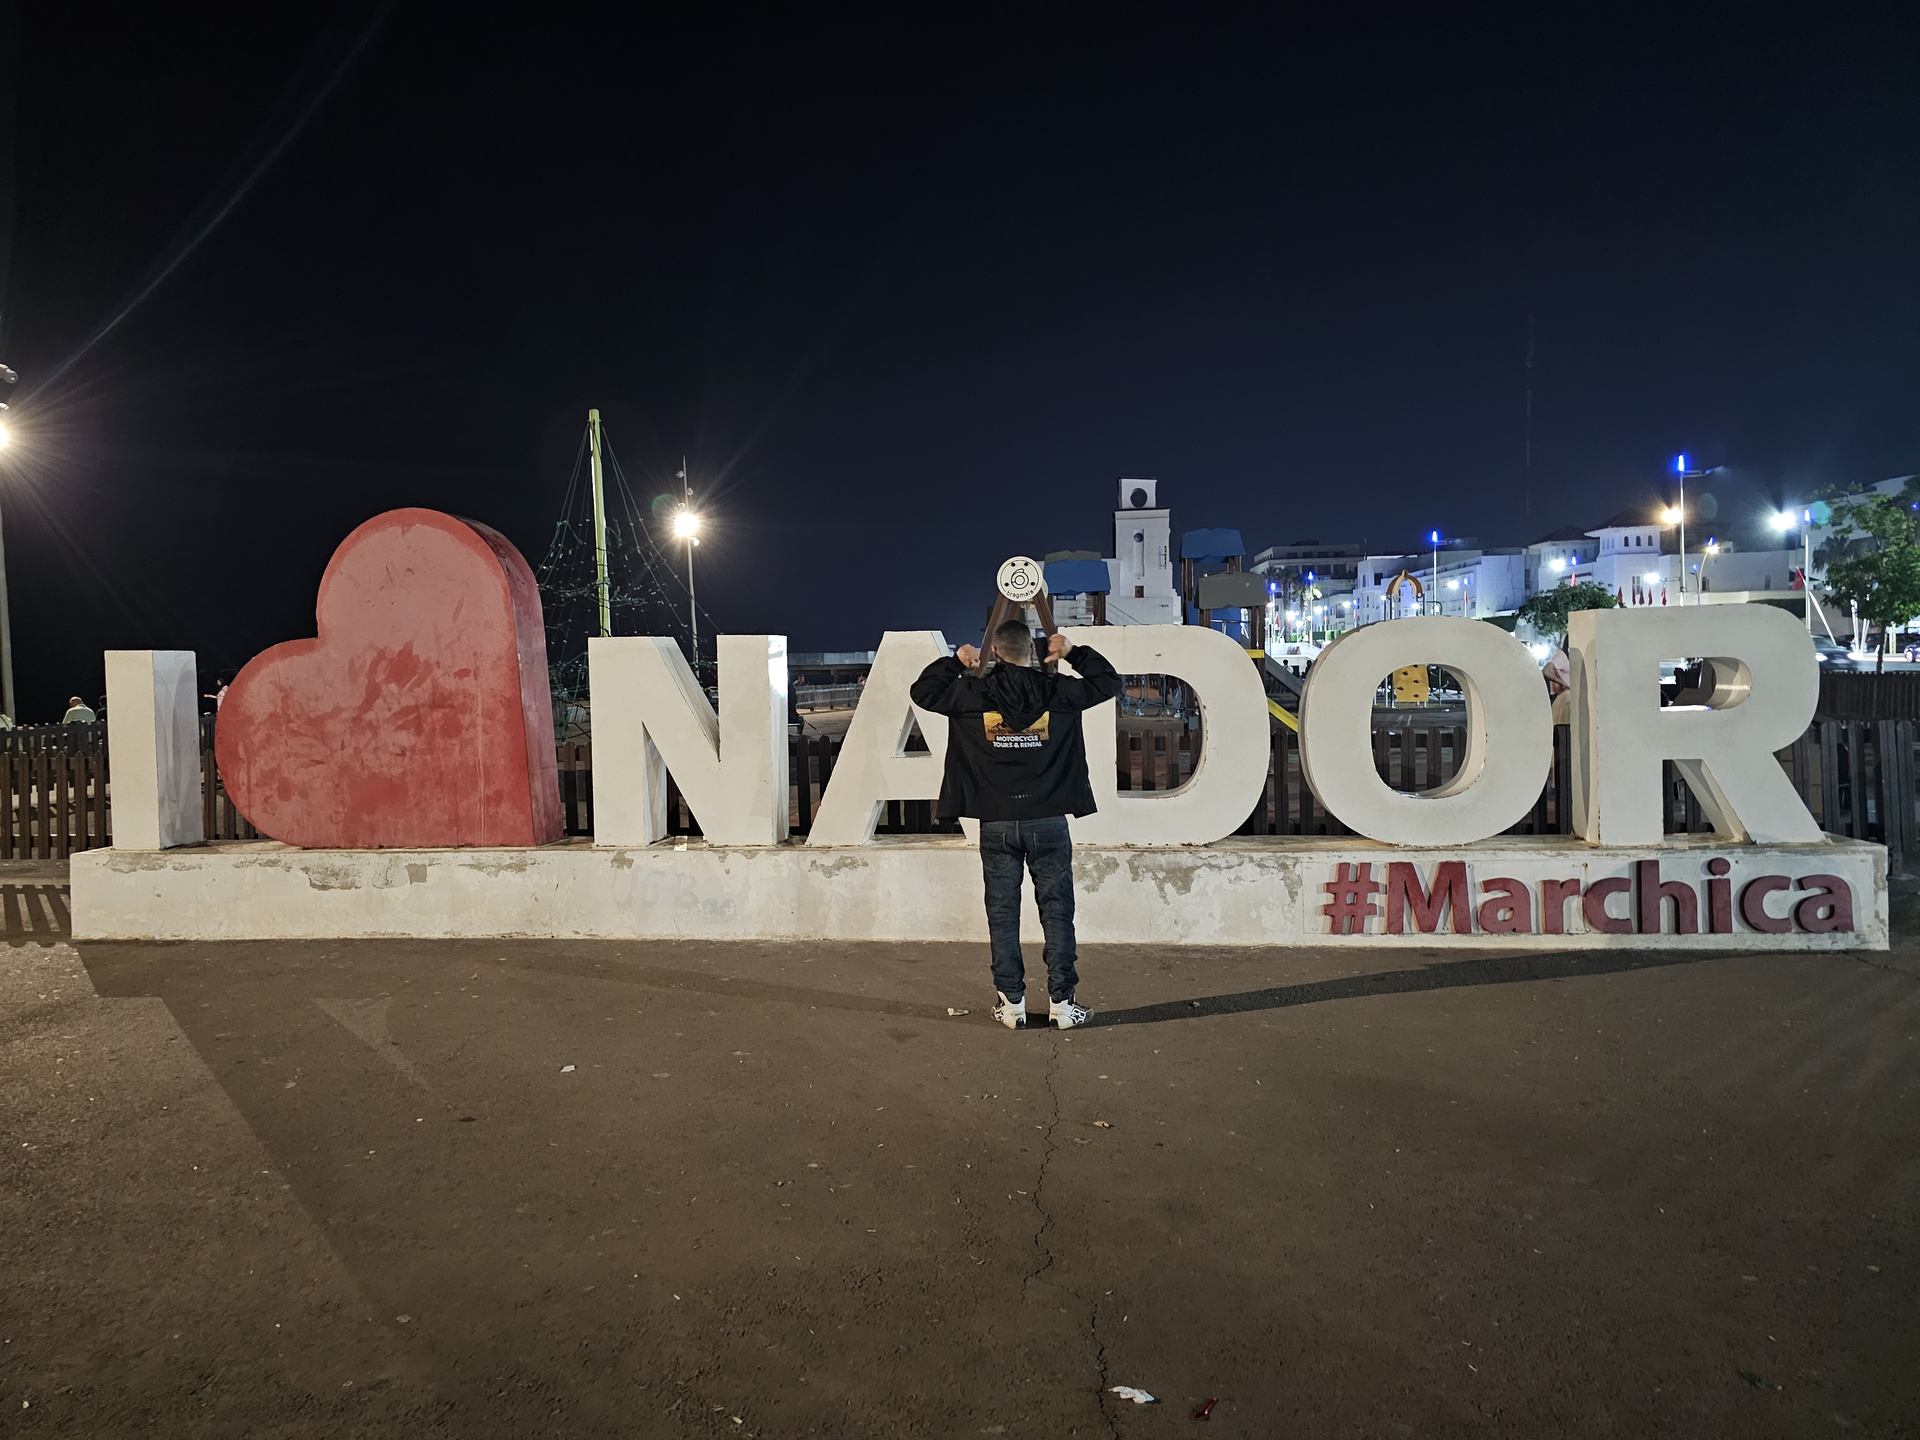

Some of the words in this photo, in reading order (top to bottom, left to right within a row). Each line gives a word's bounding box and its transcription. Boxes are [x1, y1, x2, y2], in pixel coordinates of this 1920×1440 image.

[104, 650, 200, 850] I
[588, 604, 1823, 848] NADOR
[1322, 859, 1855, 935] #Marchica
